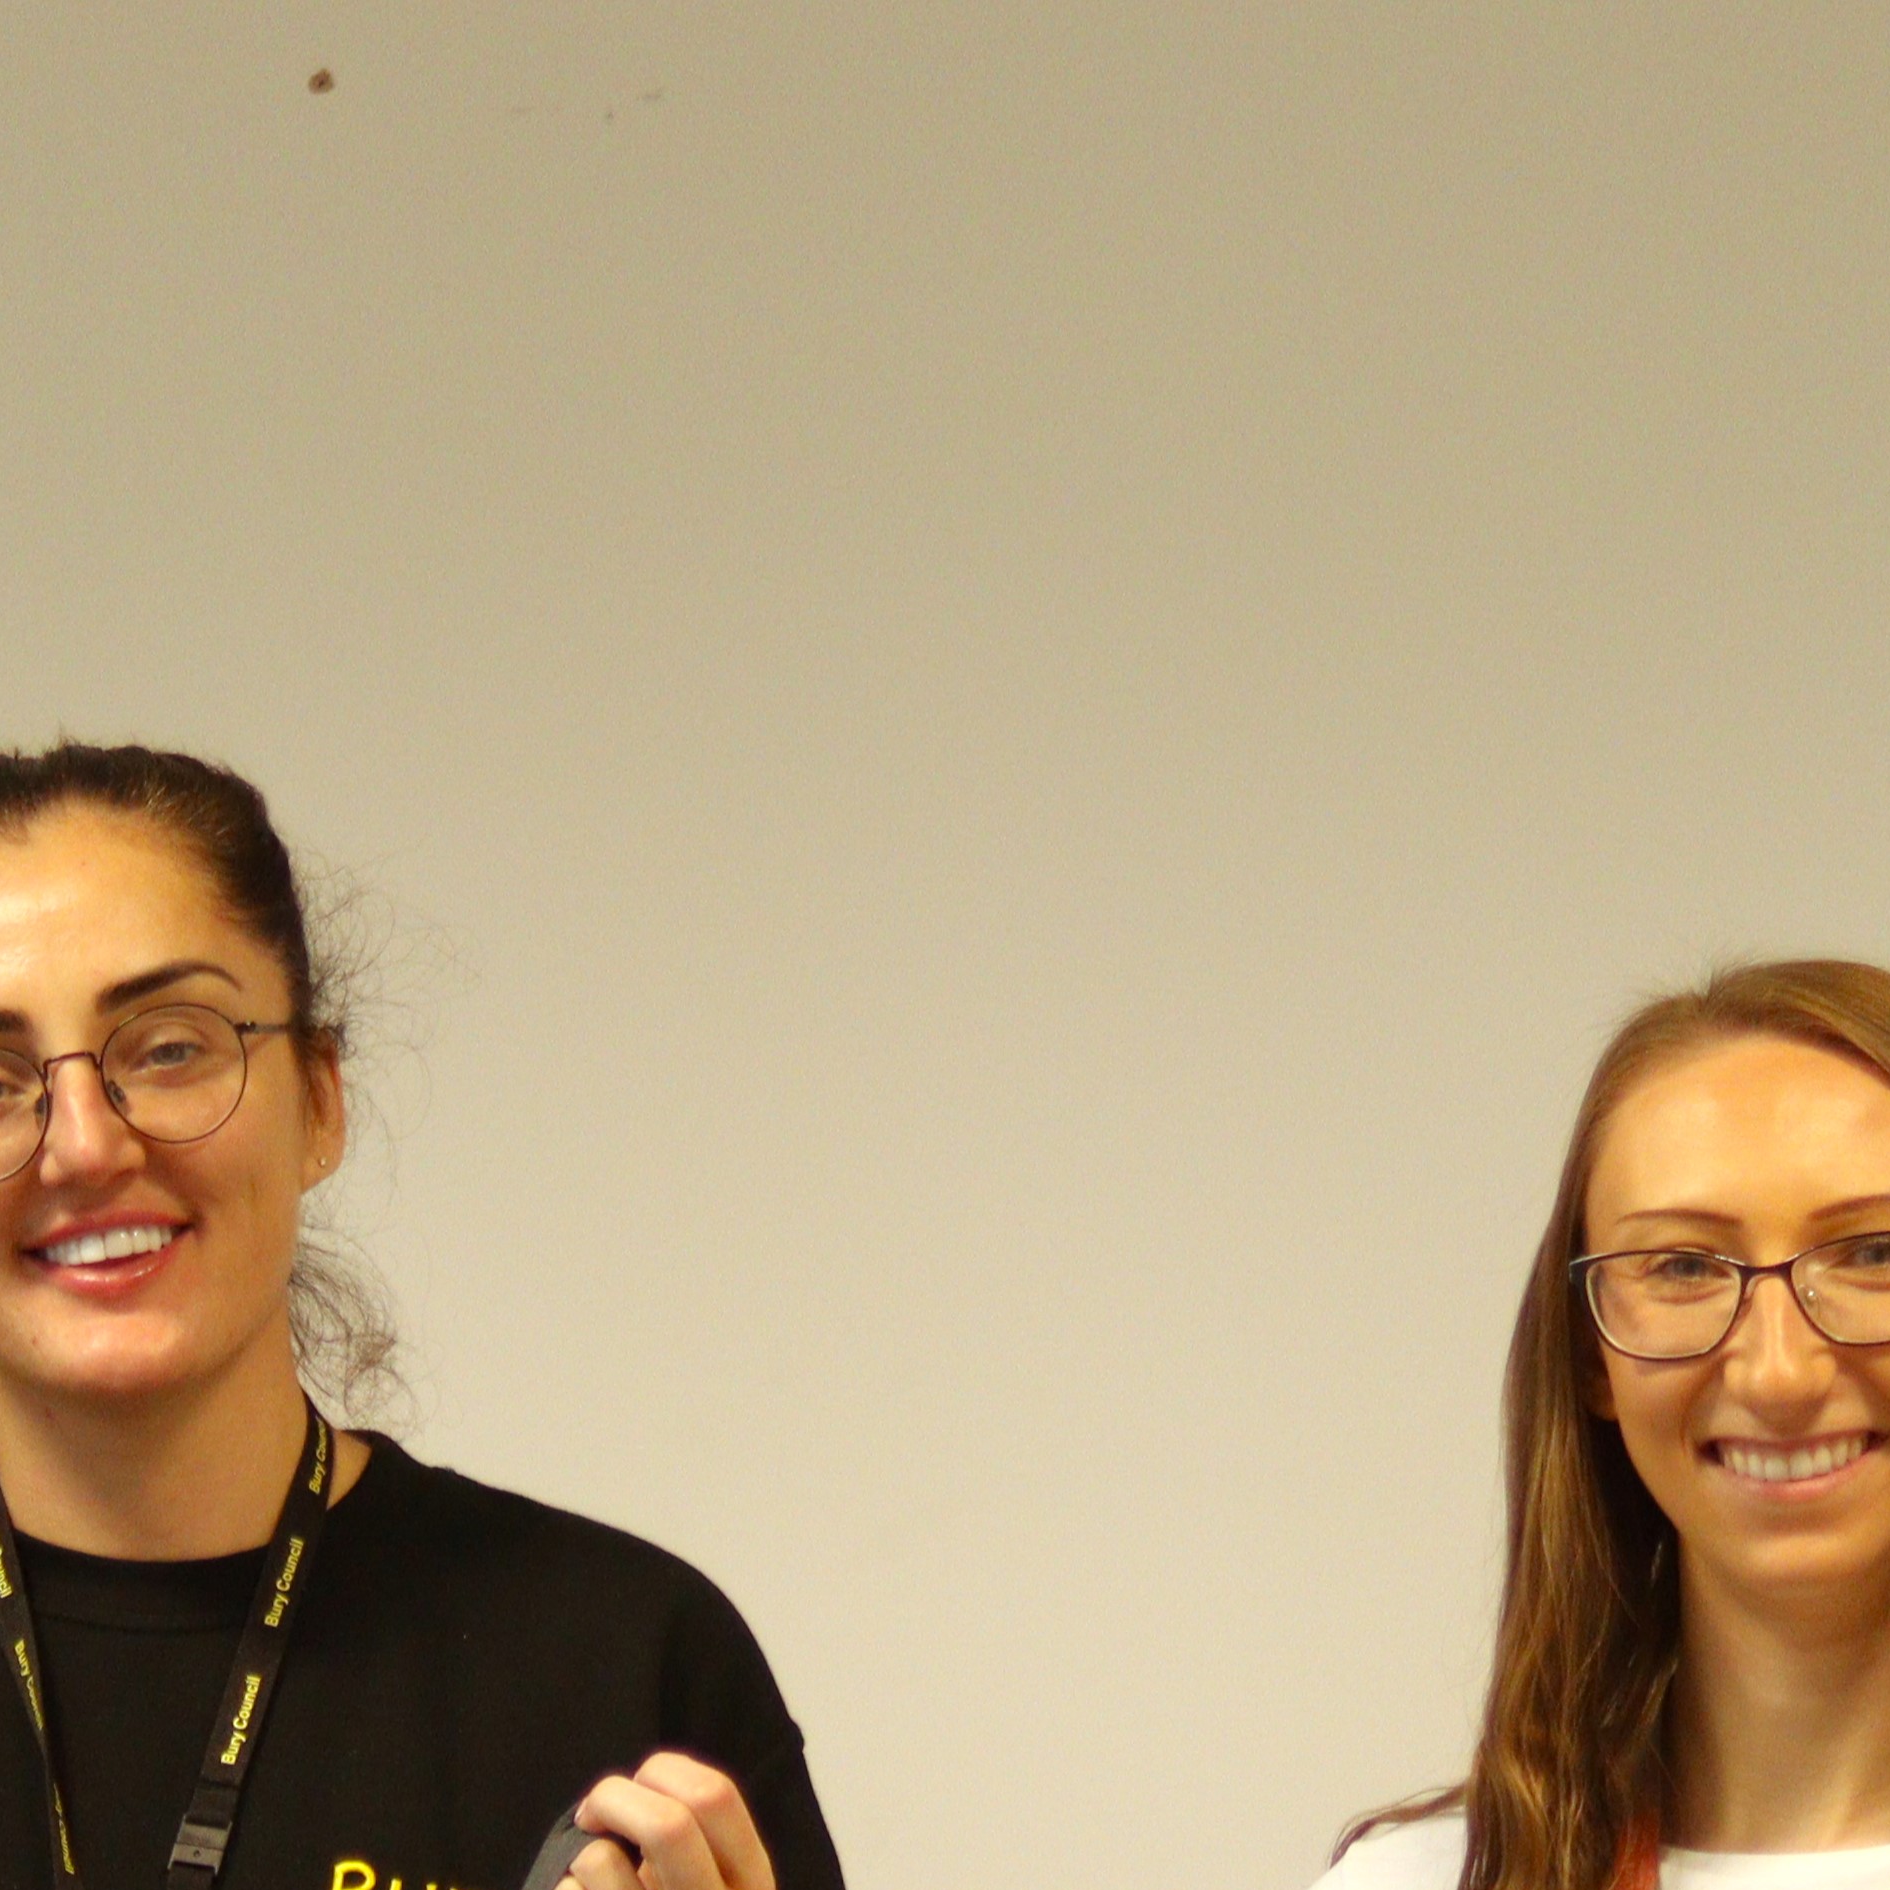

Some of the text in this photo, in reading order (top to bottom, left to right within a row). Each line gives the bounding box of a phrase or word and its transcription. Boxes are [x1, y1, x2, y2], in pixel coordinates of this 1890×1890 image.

[309, 1461, 325, 1495] Bury
[264, 1537, 304, 1627] Bury Council
[221, 1674, 262, 1766] Bury Council
